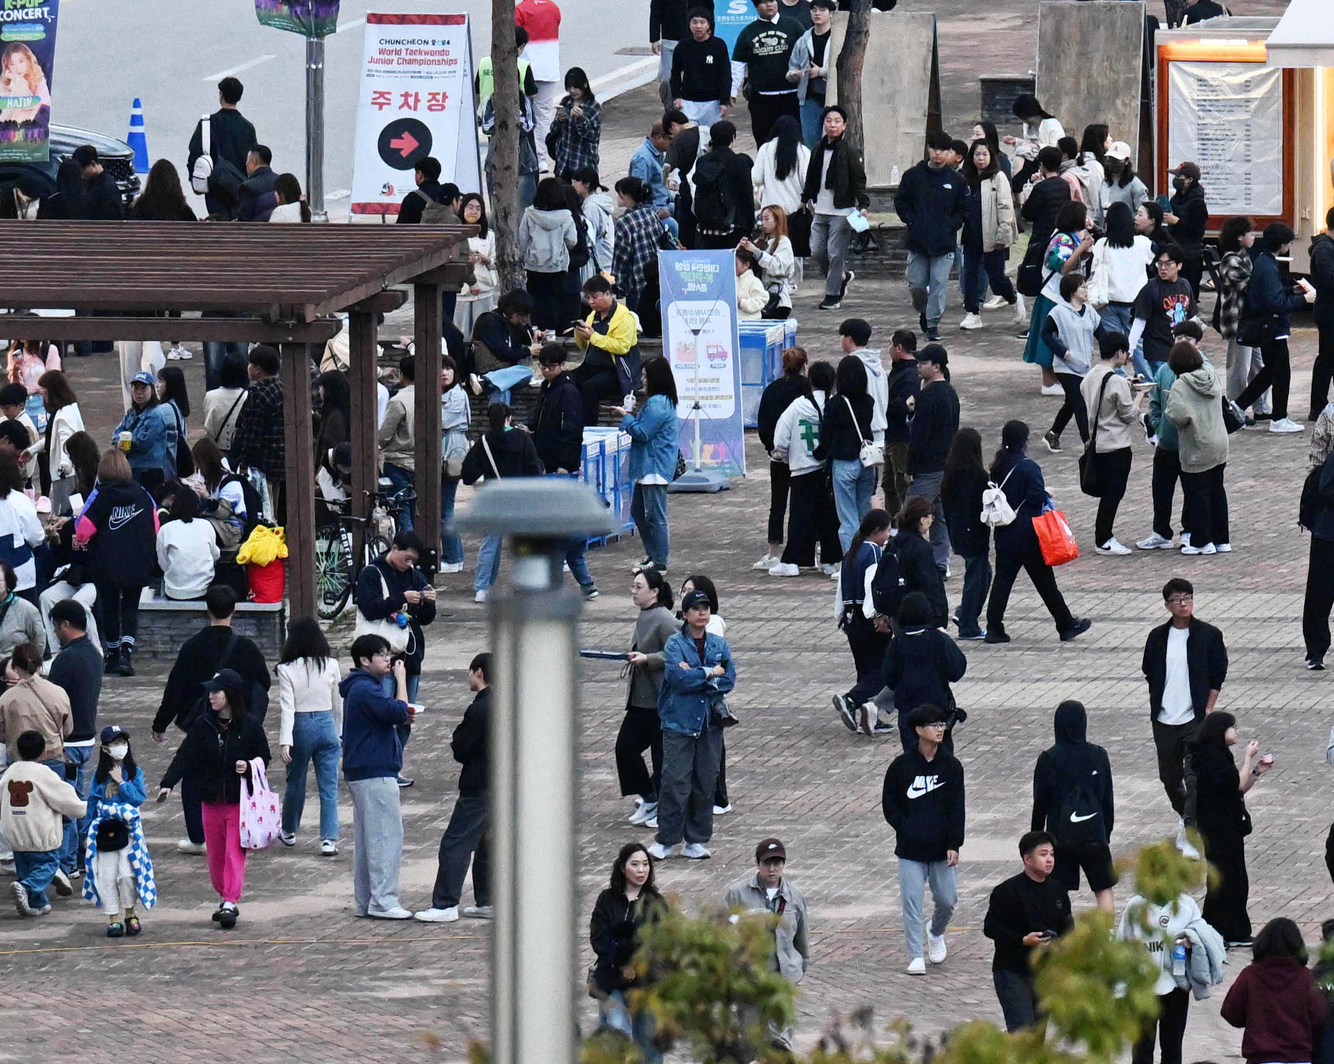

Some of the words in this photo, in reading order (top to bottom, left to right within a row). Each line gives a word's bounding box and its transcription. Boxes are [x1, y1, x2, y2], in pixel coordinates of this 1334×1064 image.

[378, 38, 429, 46] CHUNCHEON
[378, 47, 402, 56] World
[405, 48, 451, 57] Taekwondo
[367, 56, 394, 65] Junior
[397, 57, 458, 66] Championships
[370, 90, 449, 112] 주차장
[112, 504, 136, 520] NIKE
